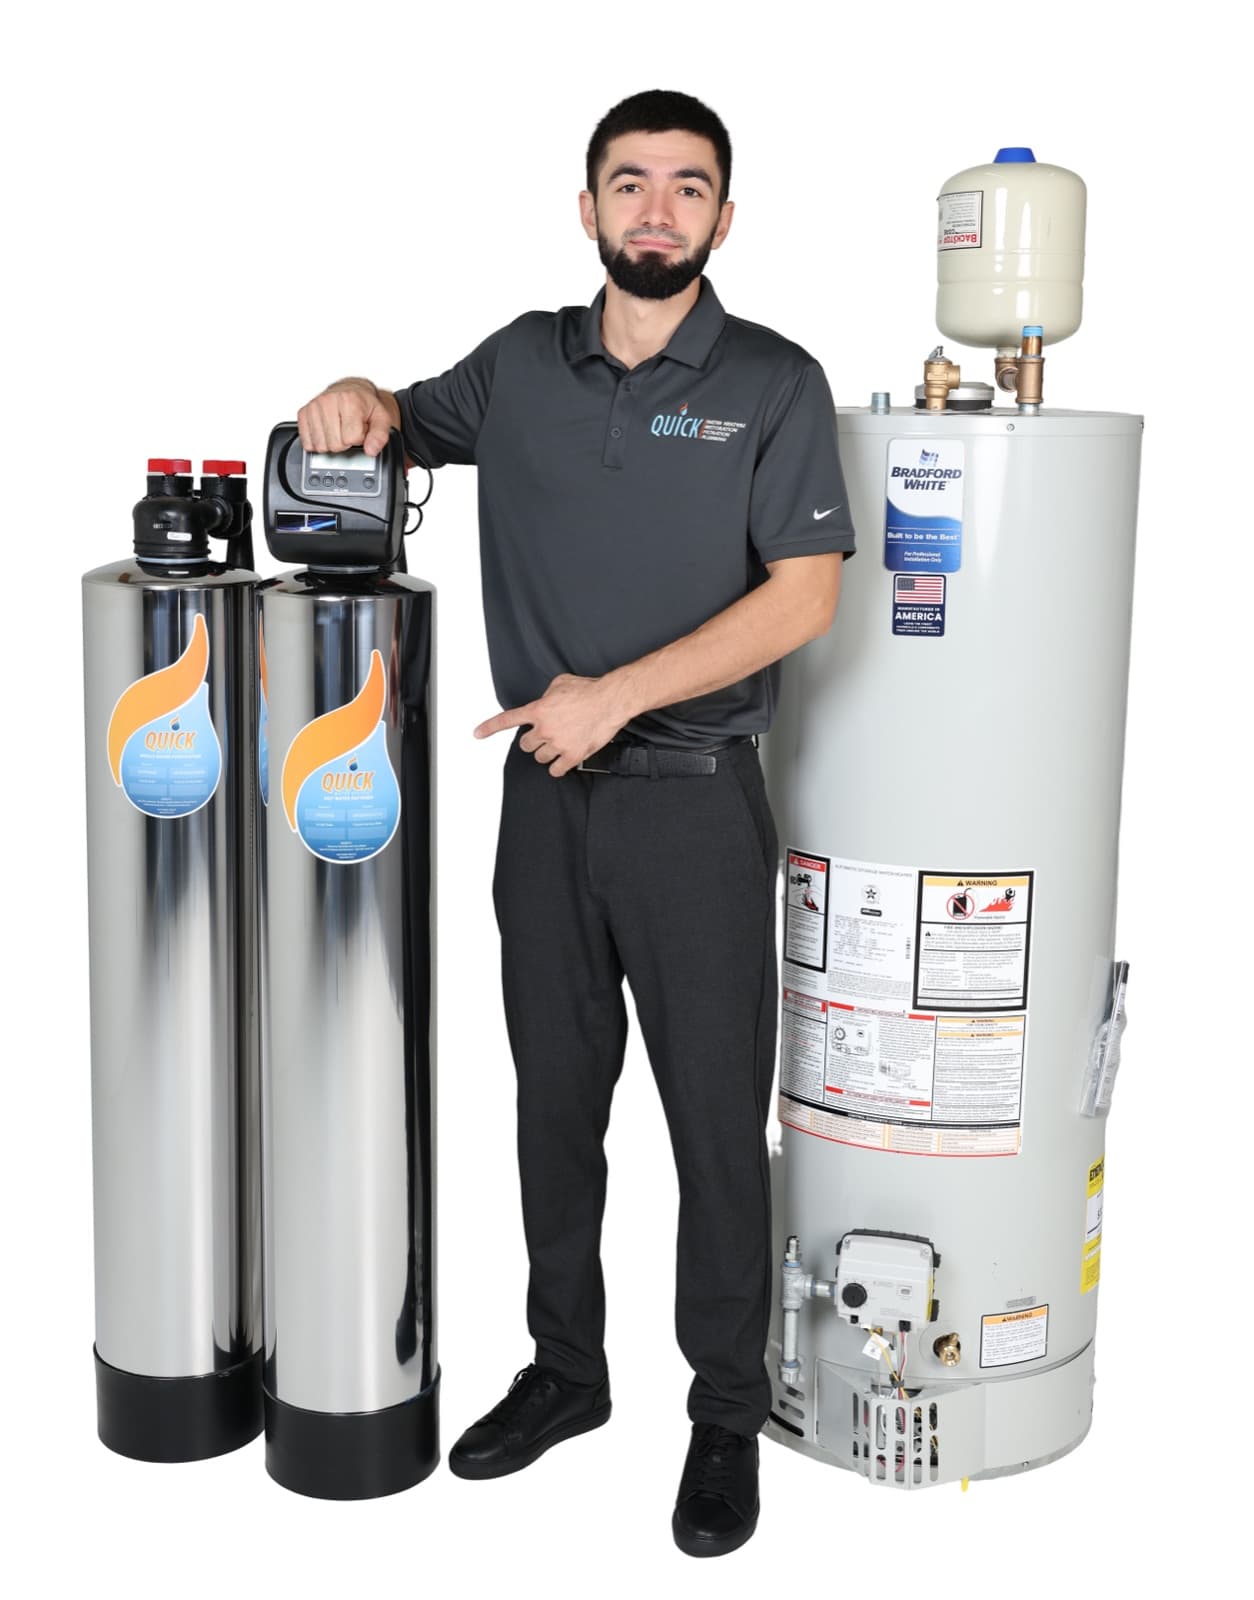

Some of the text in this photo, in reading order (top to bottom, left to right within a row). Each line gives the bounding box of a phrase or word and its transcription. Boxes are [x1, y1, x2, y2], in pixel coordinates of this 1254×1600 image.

[651, 414, 704, 439] QUICK
[891, 466, 962, 479] BRADFORD
[903, 479, 946, 491] WHITE
[914, 532, 924, 540] be
[895, 611, 942, 621] AMERICA
[145, 731, 195, 751] QUICK
[321, 772, 375, 793] QUICK
[799, 859, 820, 870] DANGER
[1006, 1312, 1033, 1321] WARNING
